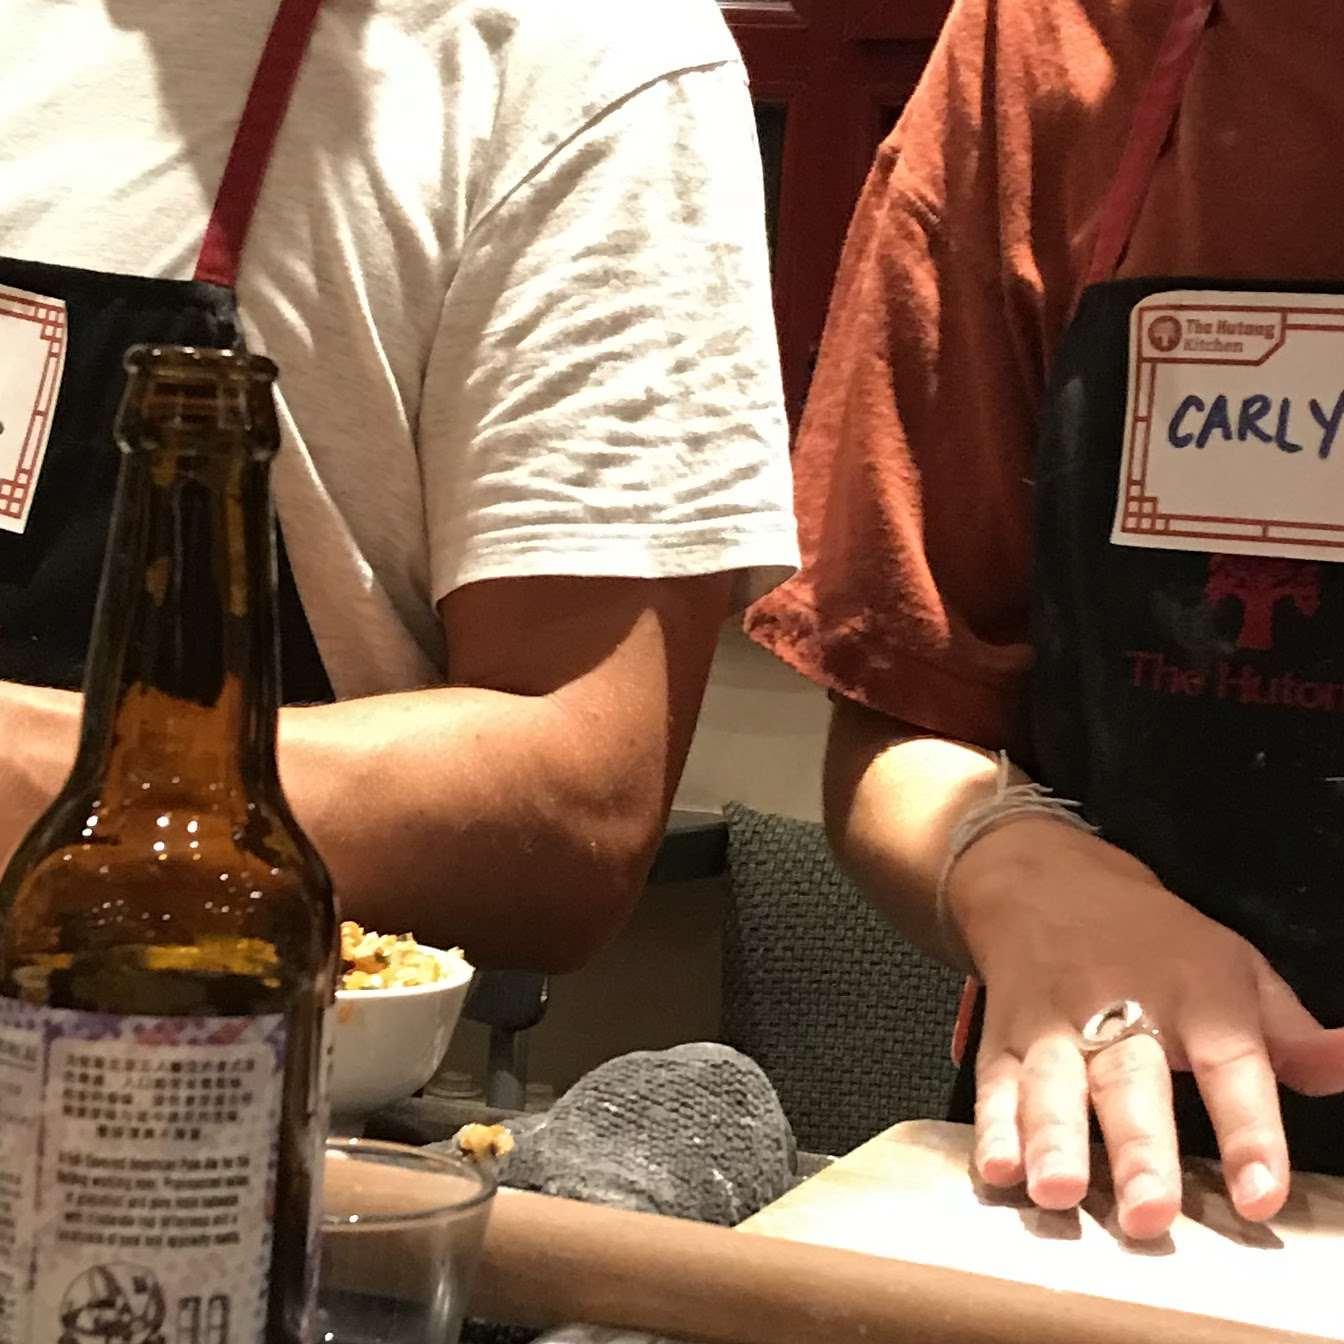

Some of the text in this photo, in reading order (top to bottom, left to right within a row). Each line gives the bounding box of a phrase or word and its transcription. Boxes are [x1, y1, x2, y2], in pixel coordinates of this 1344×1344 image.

[1186, 319, 1275, 339] The Hutong
[1183, 337, 1243, 353] Kitchen
[1127, 650, 1206, 696] The
